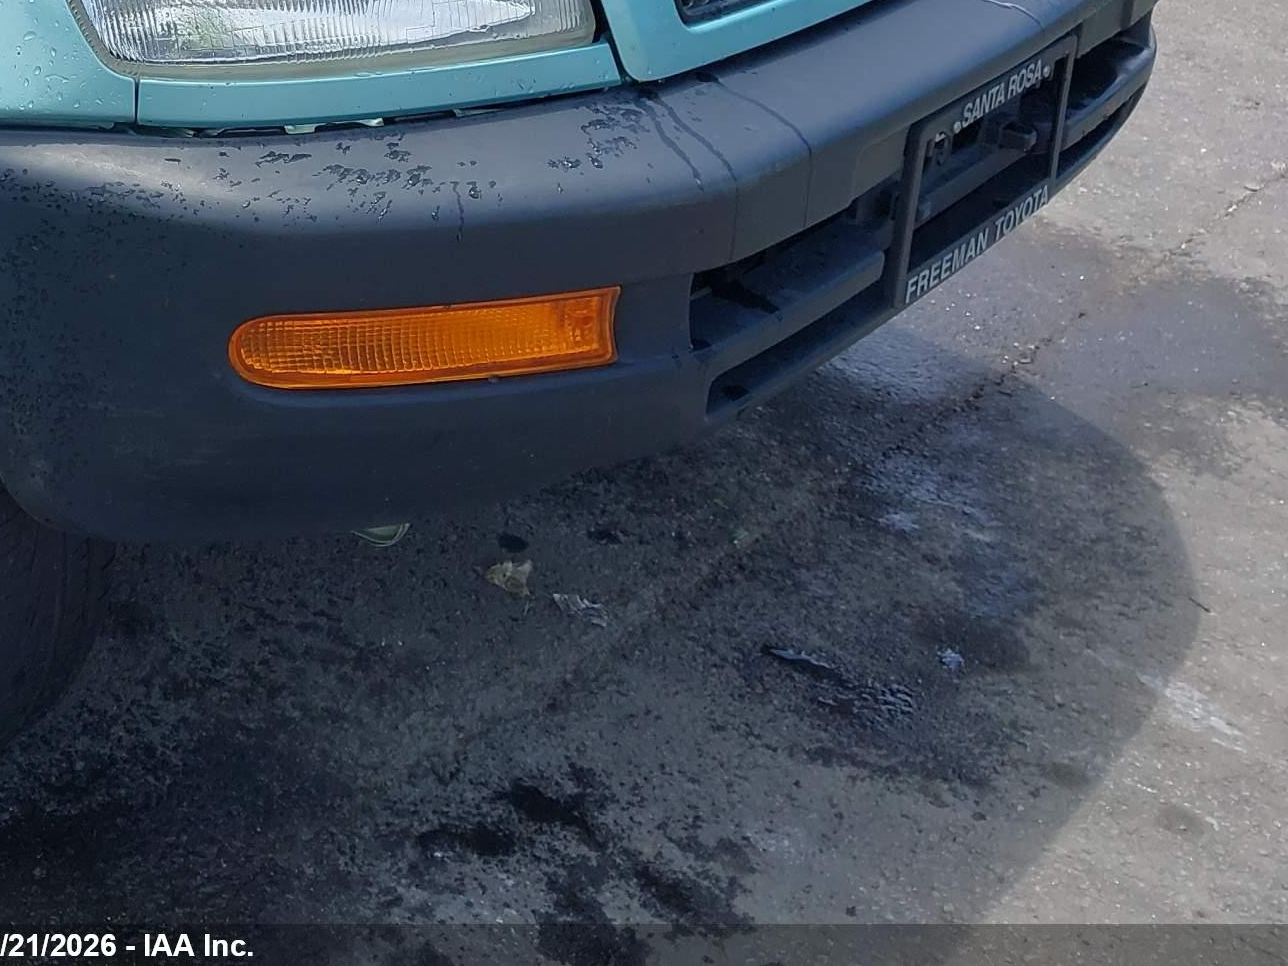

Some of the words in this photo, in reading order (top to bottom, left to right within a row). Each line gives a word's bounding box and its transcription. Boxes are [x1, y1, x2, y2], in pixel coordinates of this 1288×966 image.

[962, 83, 1005, 128] SANTA
[1007, 60, 1042, 100] ROSA
[905, 227, 989, 304] FREEMAN
[995, 185, 1049, 241] TOYOTA
